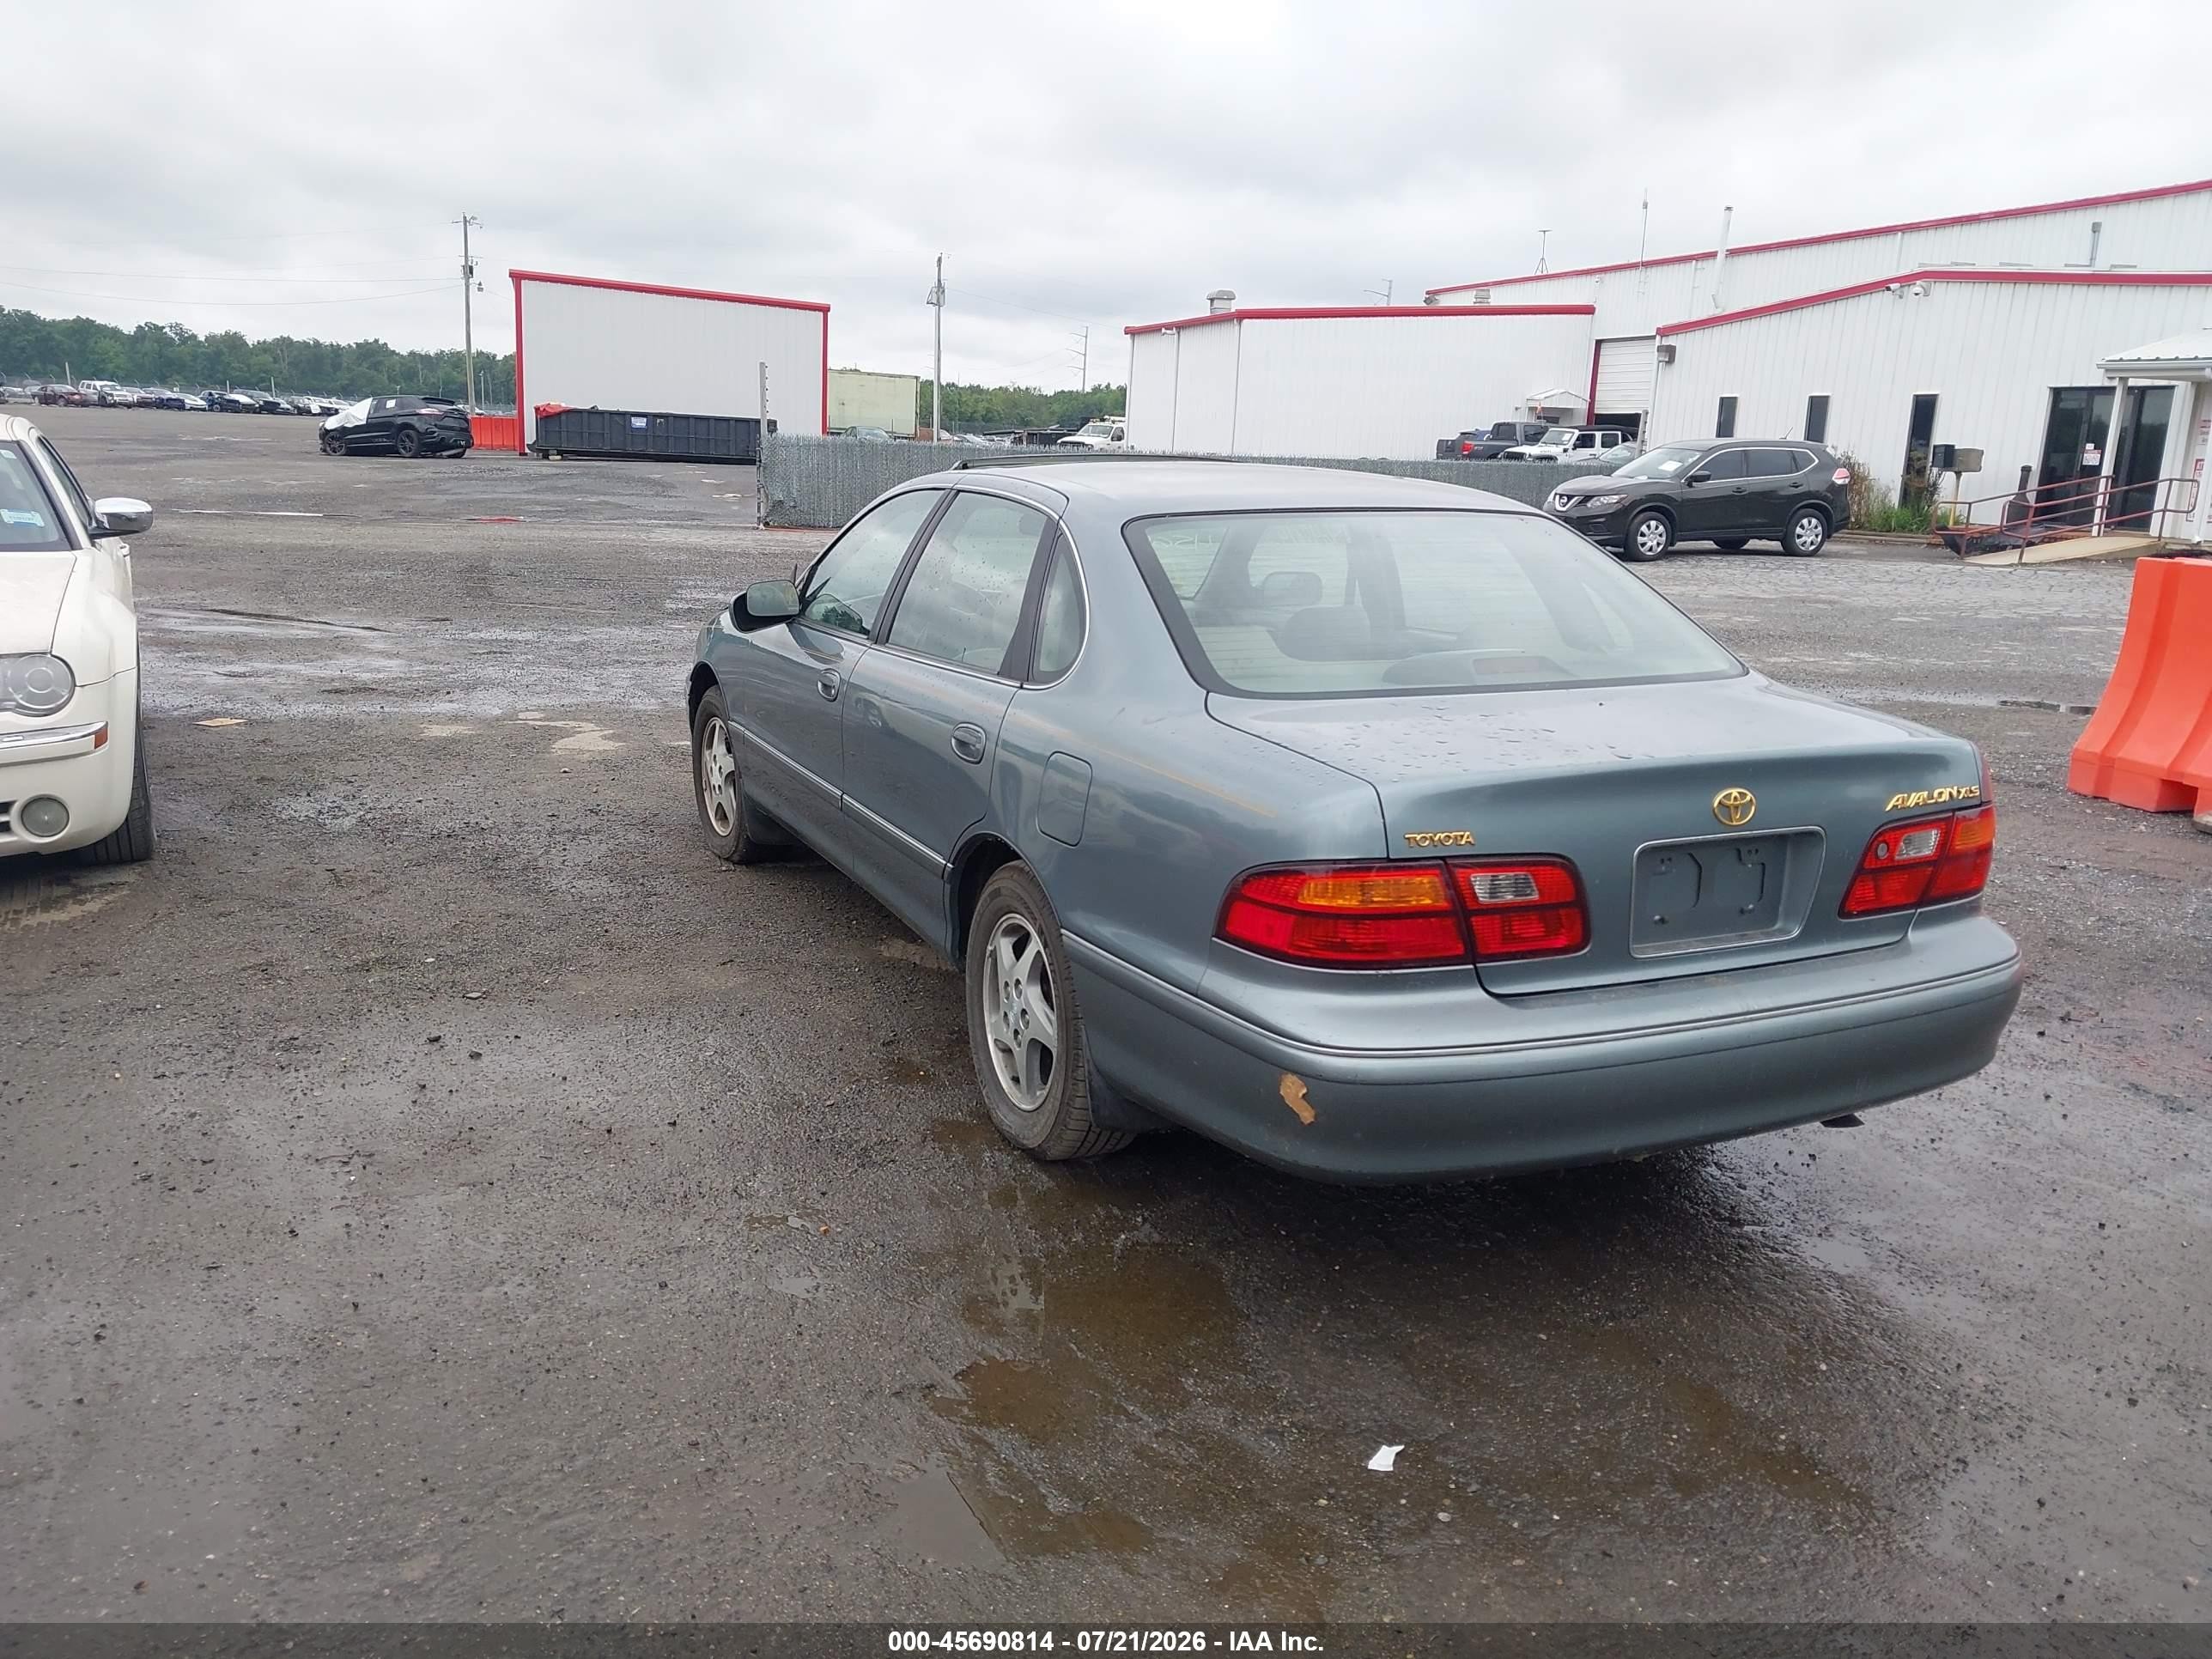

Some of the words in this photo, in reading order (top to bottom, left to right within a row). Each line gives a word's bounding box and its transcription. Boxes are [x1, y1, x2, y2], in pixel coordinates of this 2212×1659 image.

[1885, 786, 1958, 811] AVALON
[1958, 785, 1980, 799] XLS
[1404, 831, 1475, 847] TOYOTA
